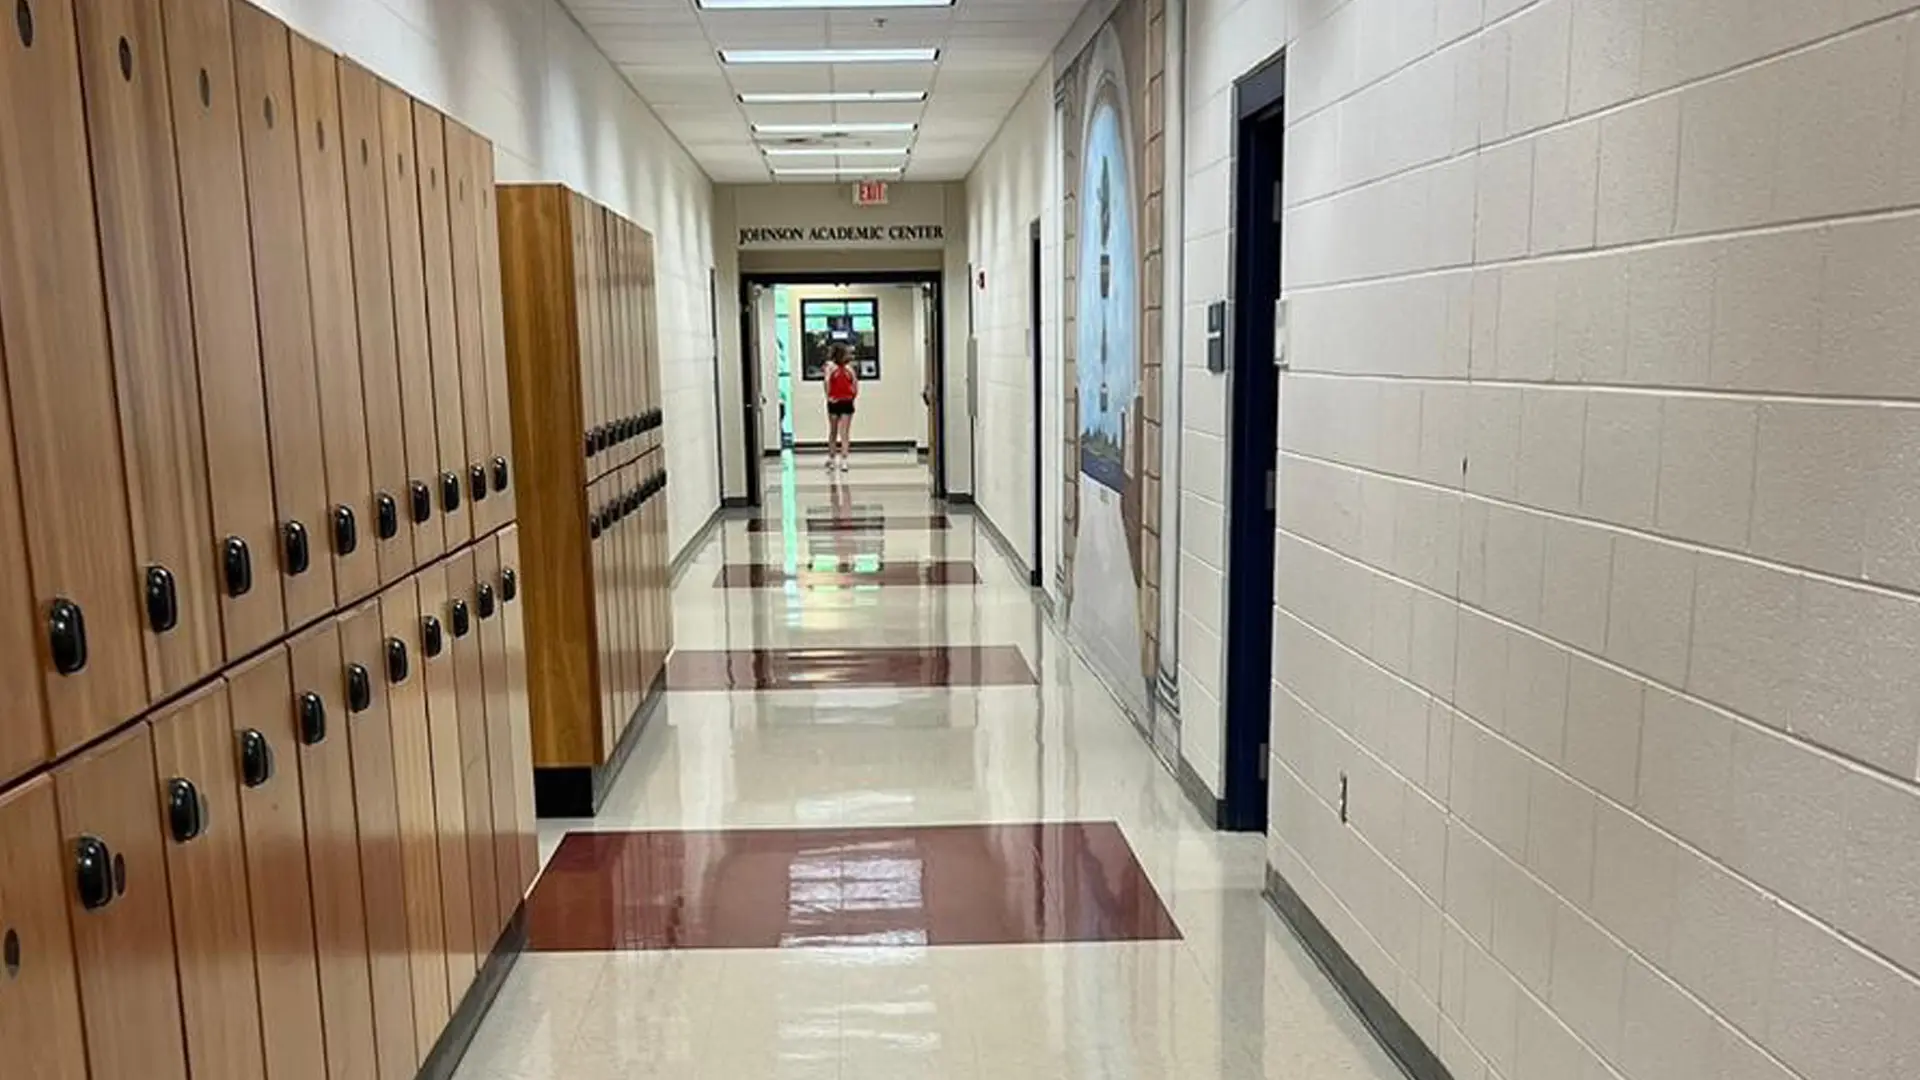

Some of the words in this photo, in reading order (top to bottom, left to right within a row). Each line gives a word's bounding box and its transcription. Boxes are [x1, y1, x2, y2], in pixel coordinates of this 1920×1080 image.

[739, 227, 803, 245] JOHNSON
[808, 225, 884, 241] ACADEMIC
[888, 225, 944, 241] CENTER
